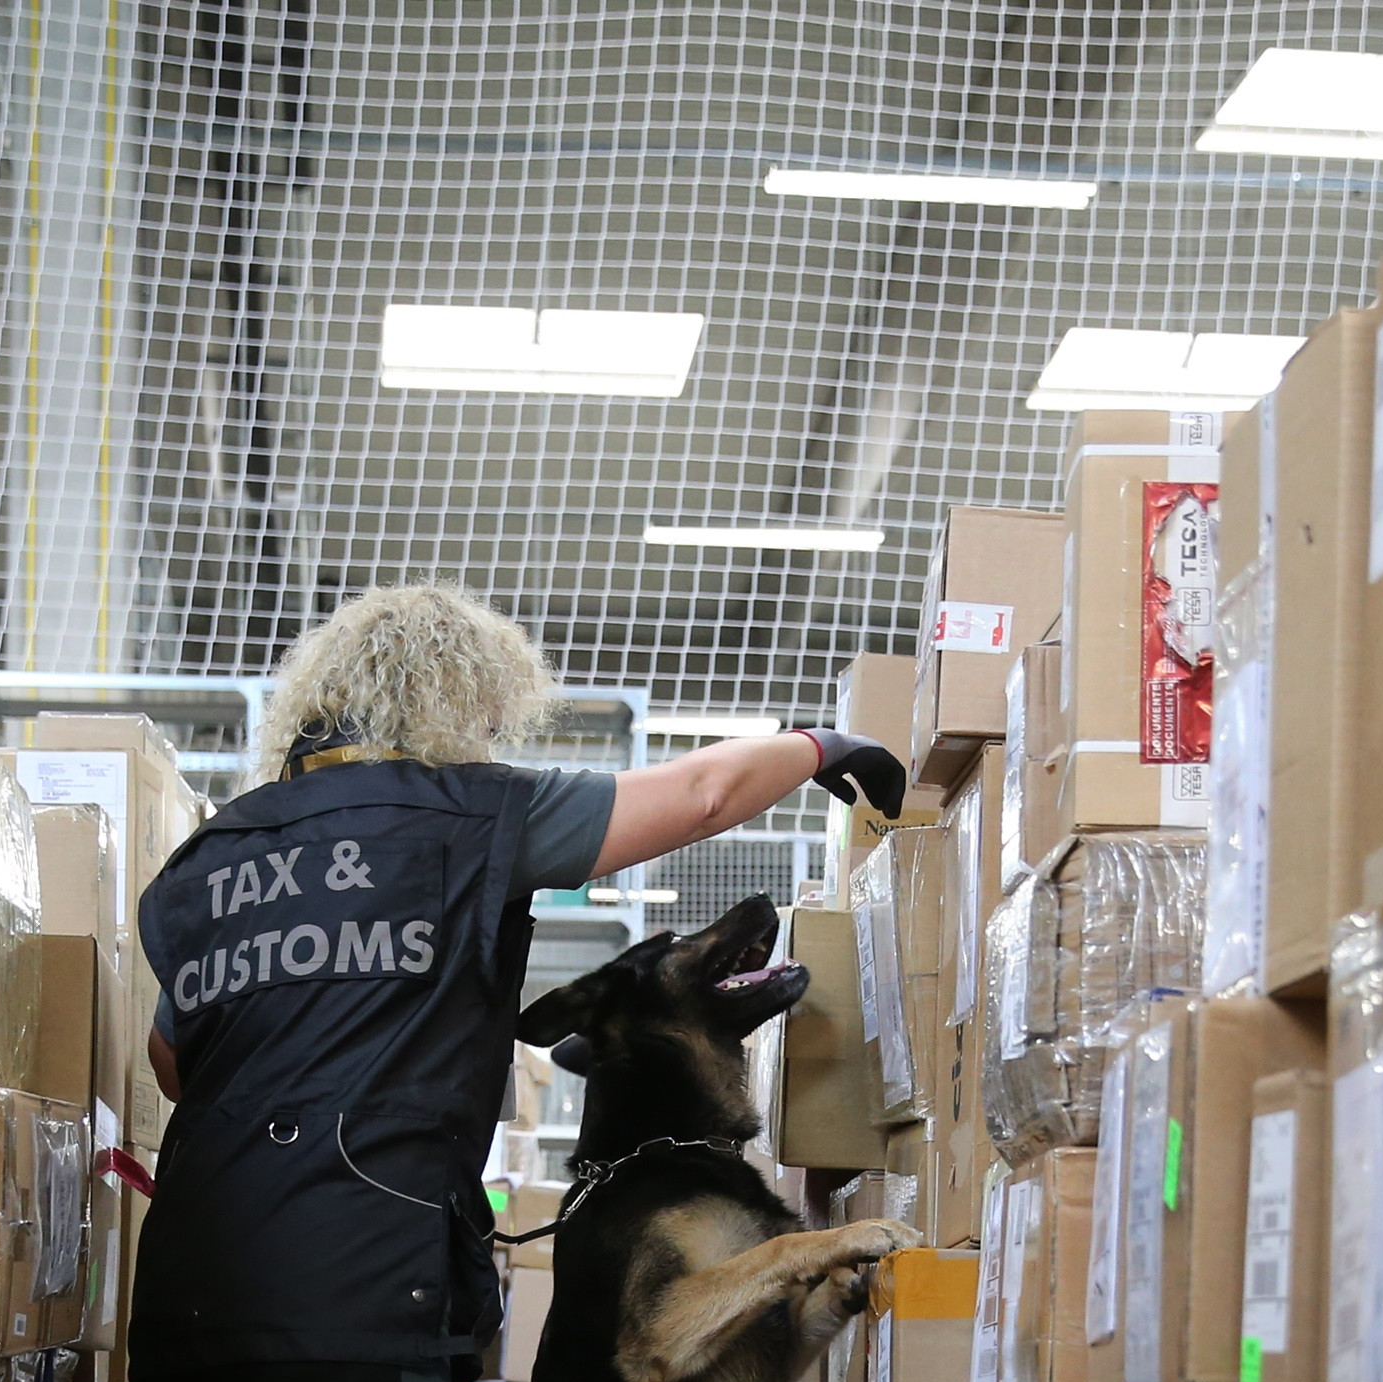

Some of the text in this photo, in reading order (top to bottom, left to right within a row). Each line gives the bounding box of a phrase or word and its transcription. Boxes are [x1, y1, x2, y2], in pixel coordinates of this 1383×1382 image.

[1180, 508, 1197, 577] TESA
[1199, 510, 1208, 577] TECHNOLOG
[1191, 589, 1202, 622] TESA
[1151, 682, 1163, 756] DOKUMENTE
[1164, 682, 1175, 757] DOCUMENTS
[1191, 765, 1202, 797] TESA
[207, 839, 376, 919] TAX &
[173, 920, 436, 1013] CUSTOMS
